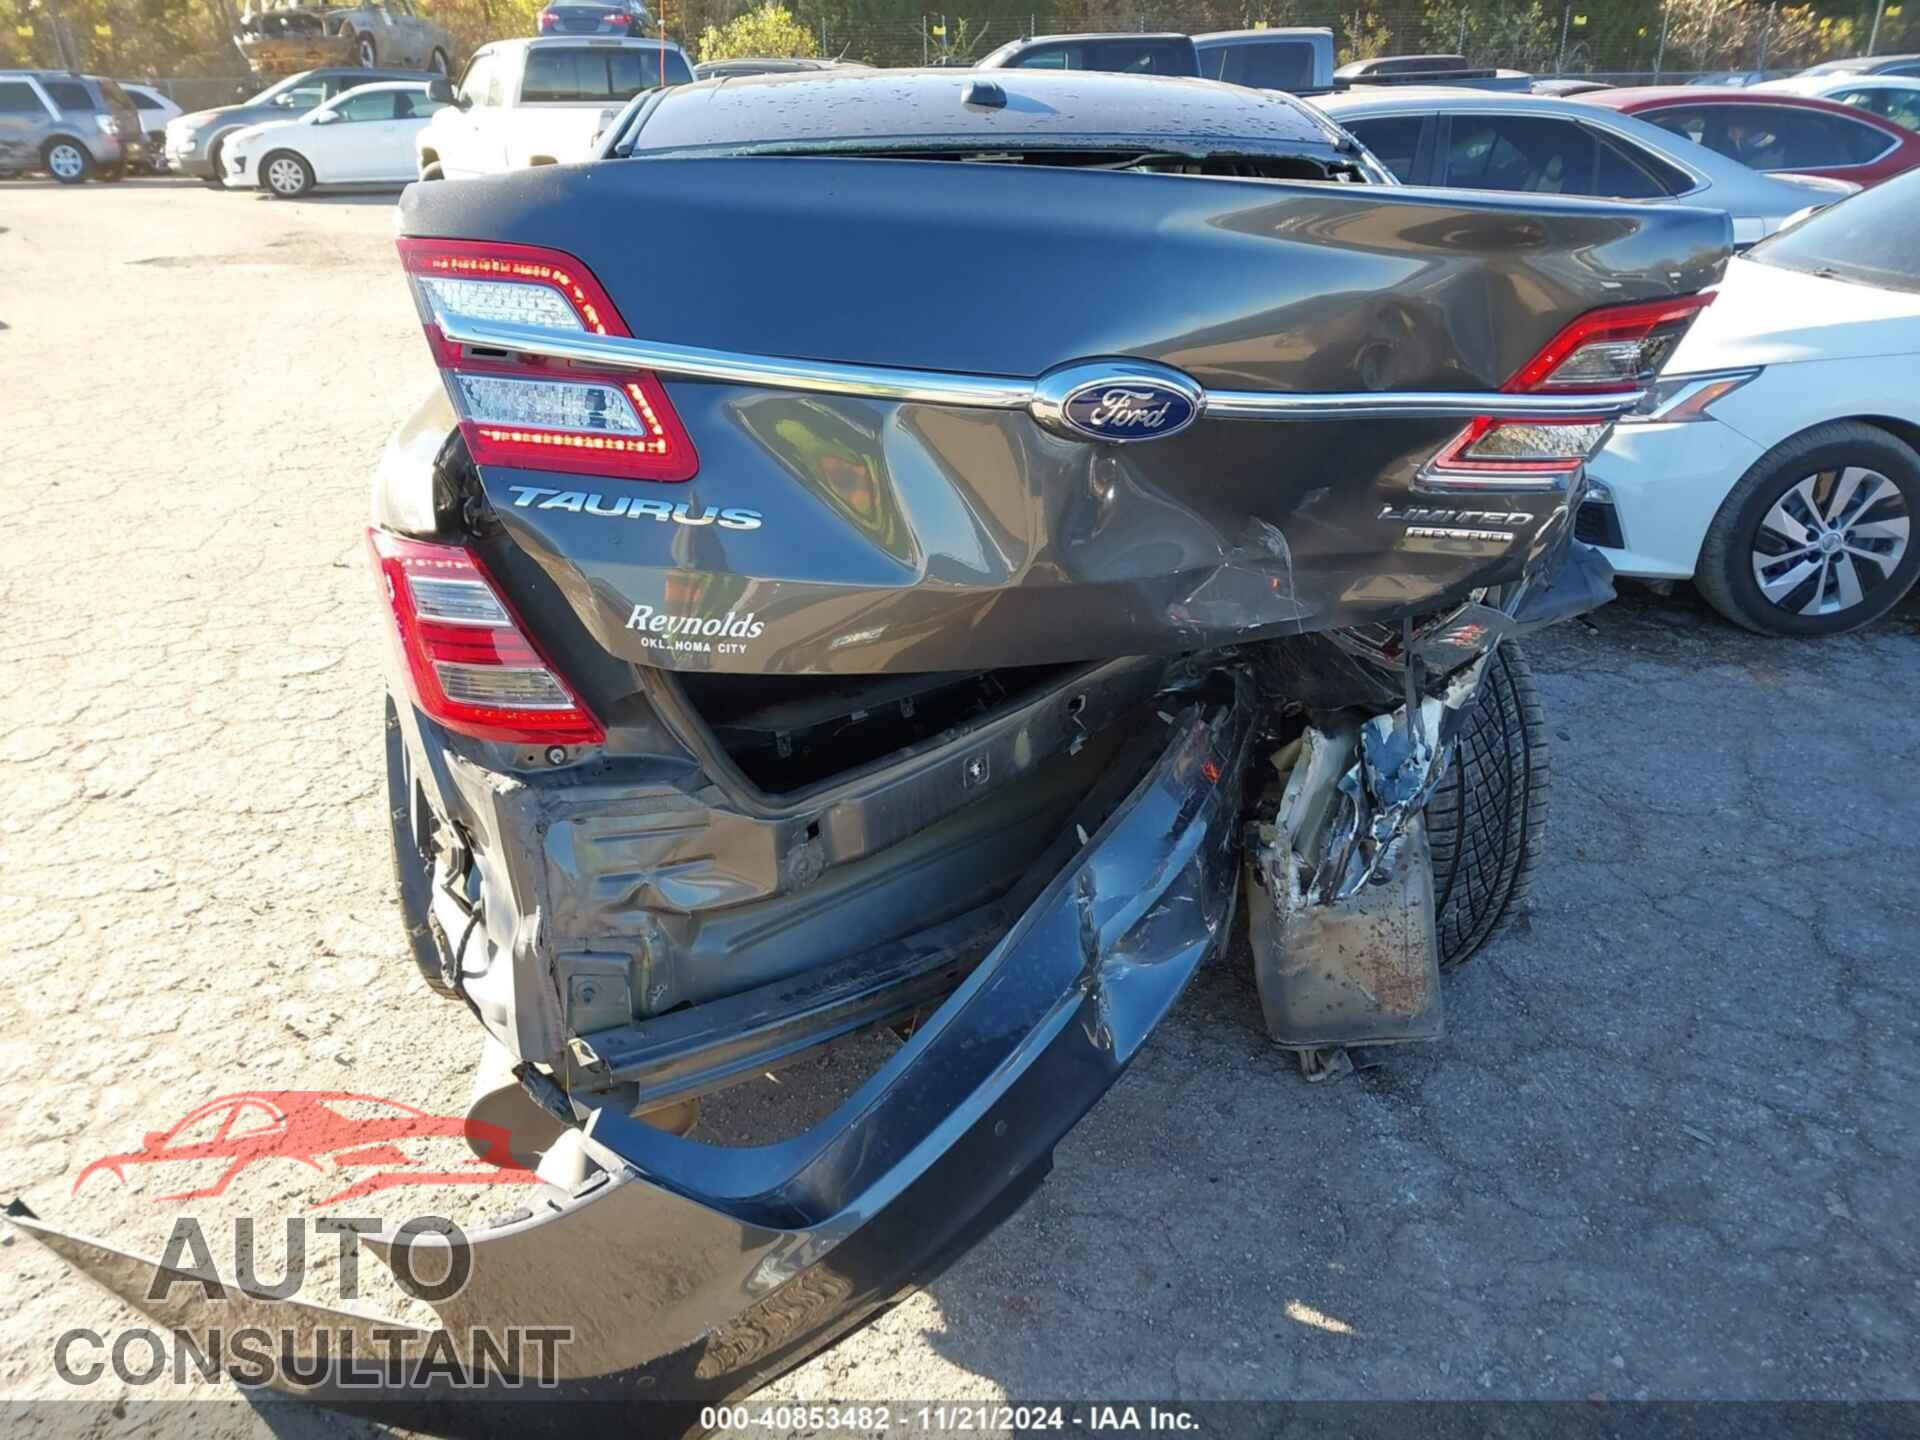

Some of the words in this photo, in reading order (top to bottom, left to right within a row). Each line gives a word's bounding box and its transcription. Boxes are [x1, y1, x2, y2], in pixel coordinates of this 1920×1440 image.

[1090, 388, 1172, 428] Ford
[508, 485, 763, 530] TAURUS
[625, 603, 765, 639] Reynolds
[718, 642, 747, 654] CITY
